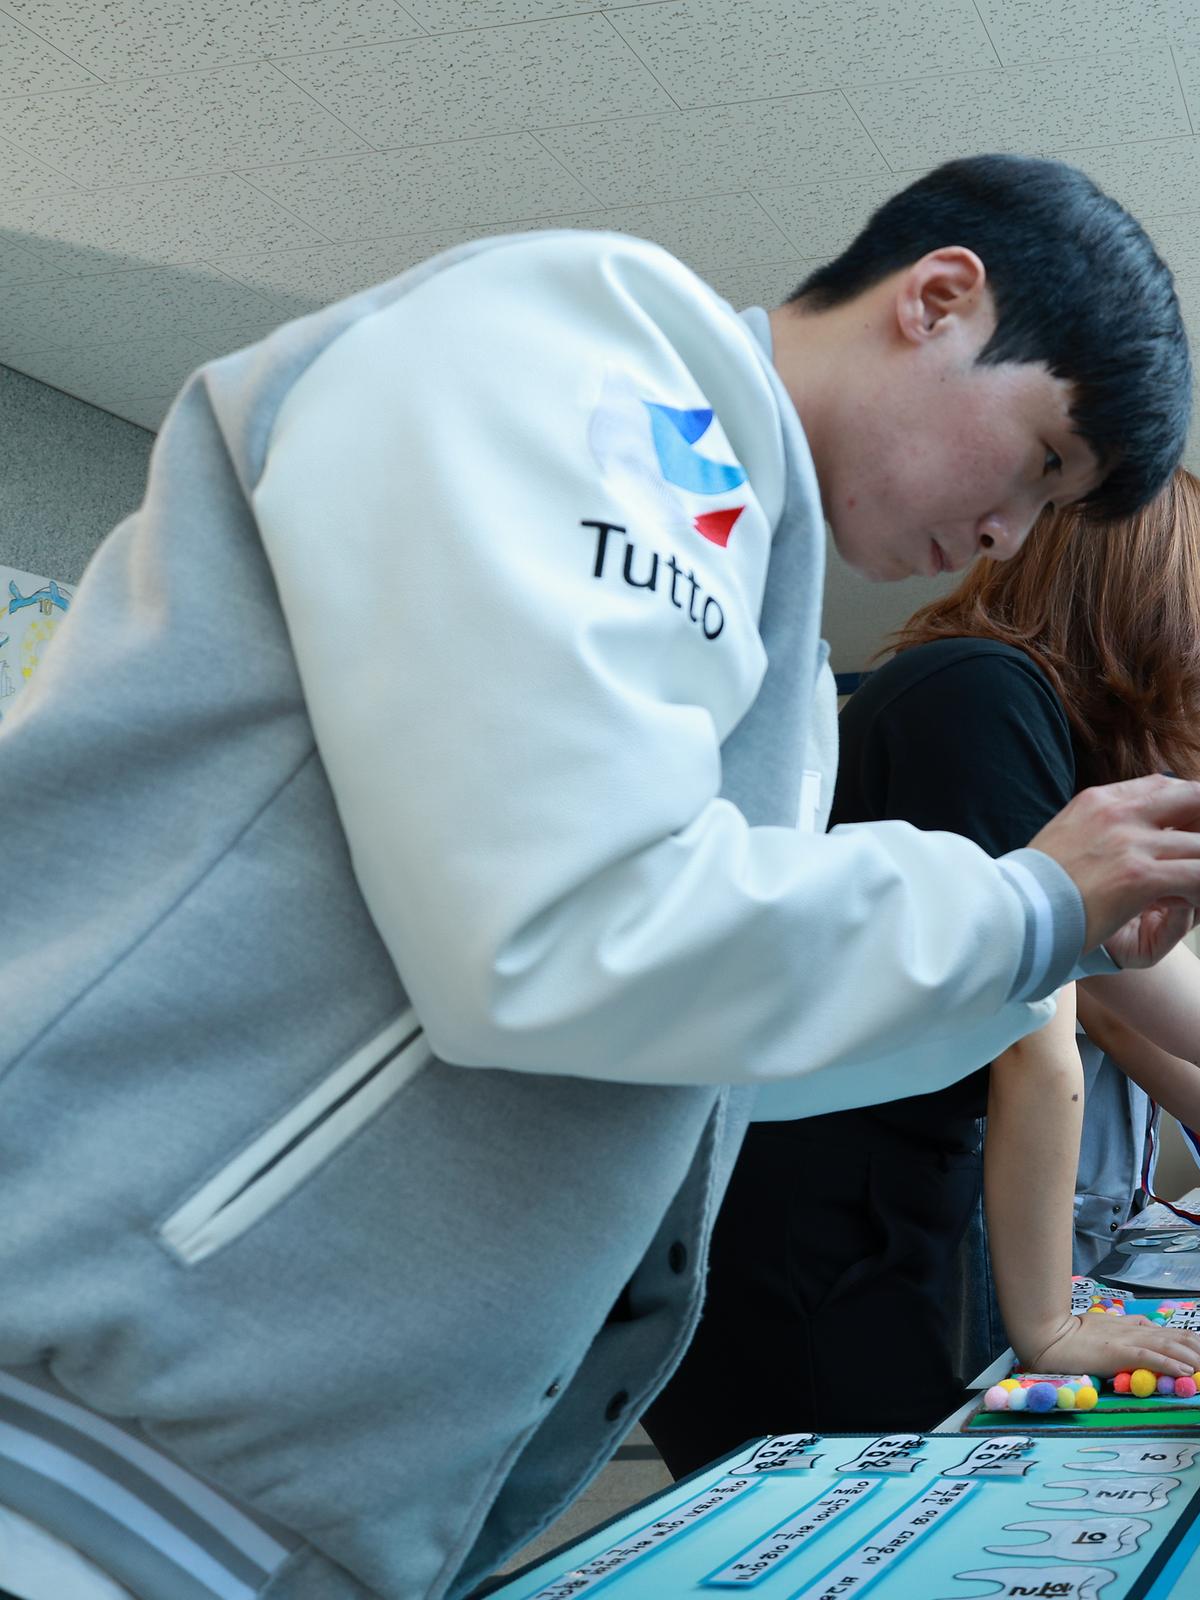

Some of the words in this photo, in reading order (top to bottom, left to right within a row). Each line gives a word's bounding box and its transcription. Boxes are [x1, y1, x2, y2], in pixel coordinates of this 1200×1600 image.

[580, 520, 724, 640] Tutto
[710, 1481, 748, 1495] 이를
[833, 1481, 869, 1495] 이를
[921, 1482, 969, 1506] 깨끗한
[685, 1496, 724, 1518] 아프지
[811, 1498, 850, 1522] 닦아야
[773, 1525, 816, 1540] 하는
[862, 1530, 915, 1555] 더러운
[759, 1545, 790, 1560] 이유
